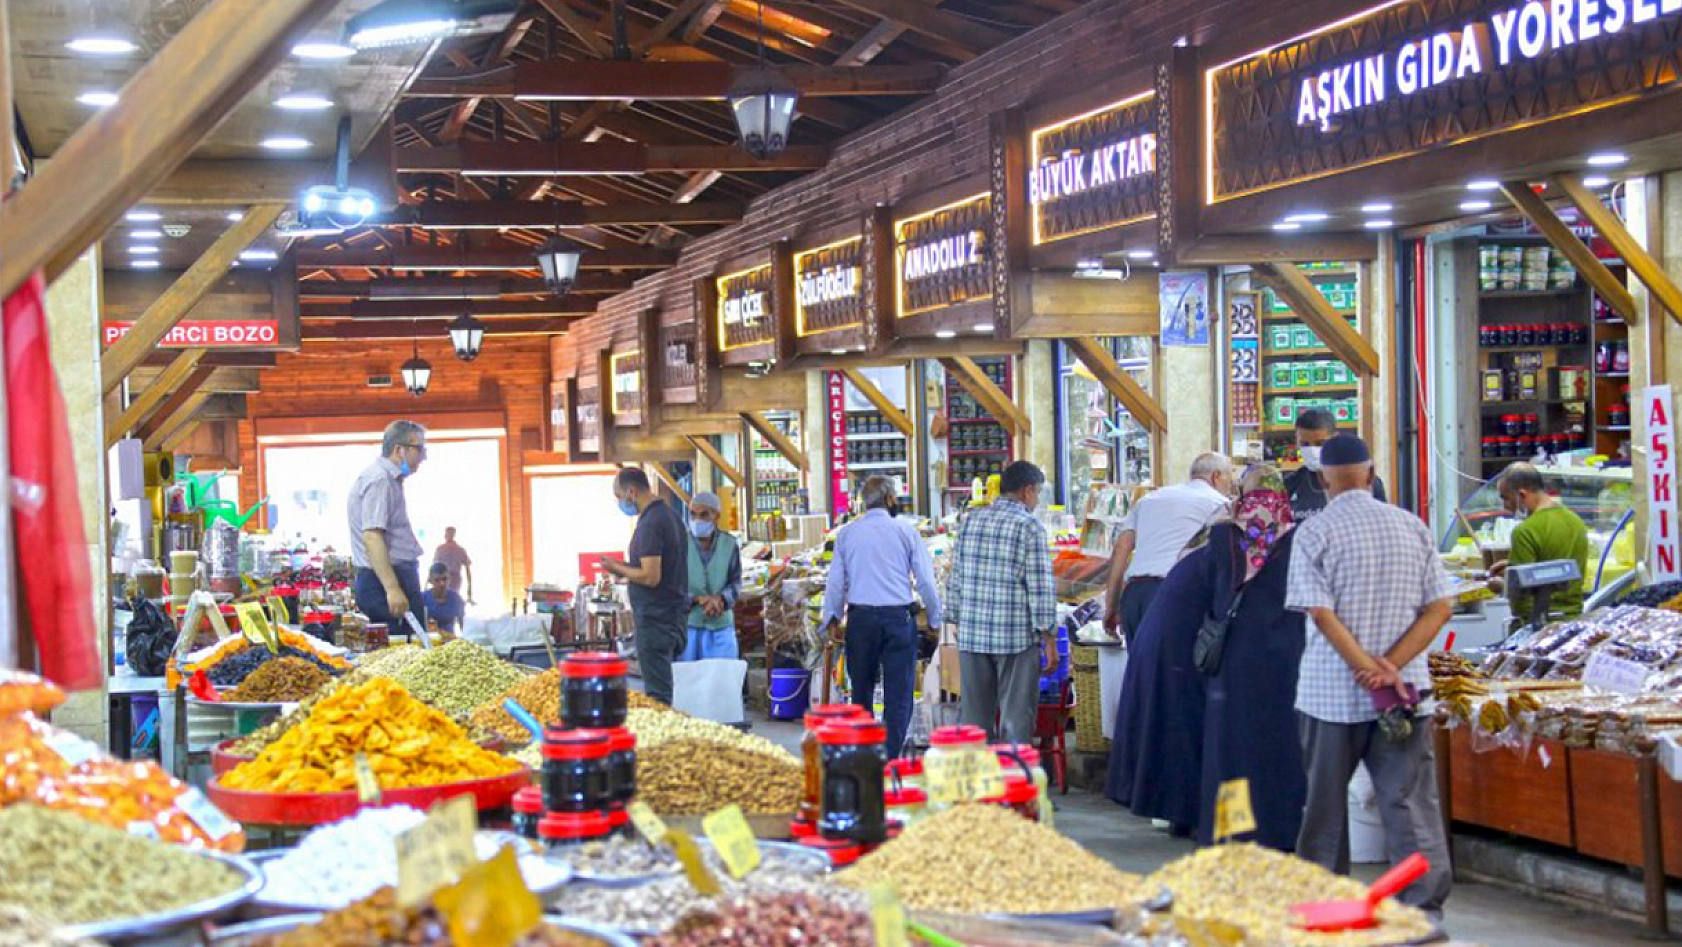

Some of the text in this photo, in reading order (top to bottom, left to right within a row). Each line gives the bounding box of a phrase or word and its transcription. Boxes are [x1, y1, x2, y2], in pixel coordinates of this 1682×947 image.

[1297, 54, 1385, 132] AŞKIN
[1397, 24, 1483, 95] GIDA
[1029, 133, 1157, 205] BÜYÜK AKTAR
[905, 235, 966, 281] ANADOLU
[214, 326, 275, 342] BOZO
[1649, 398, 1675, 573] AŞKIN
